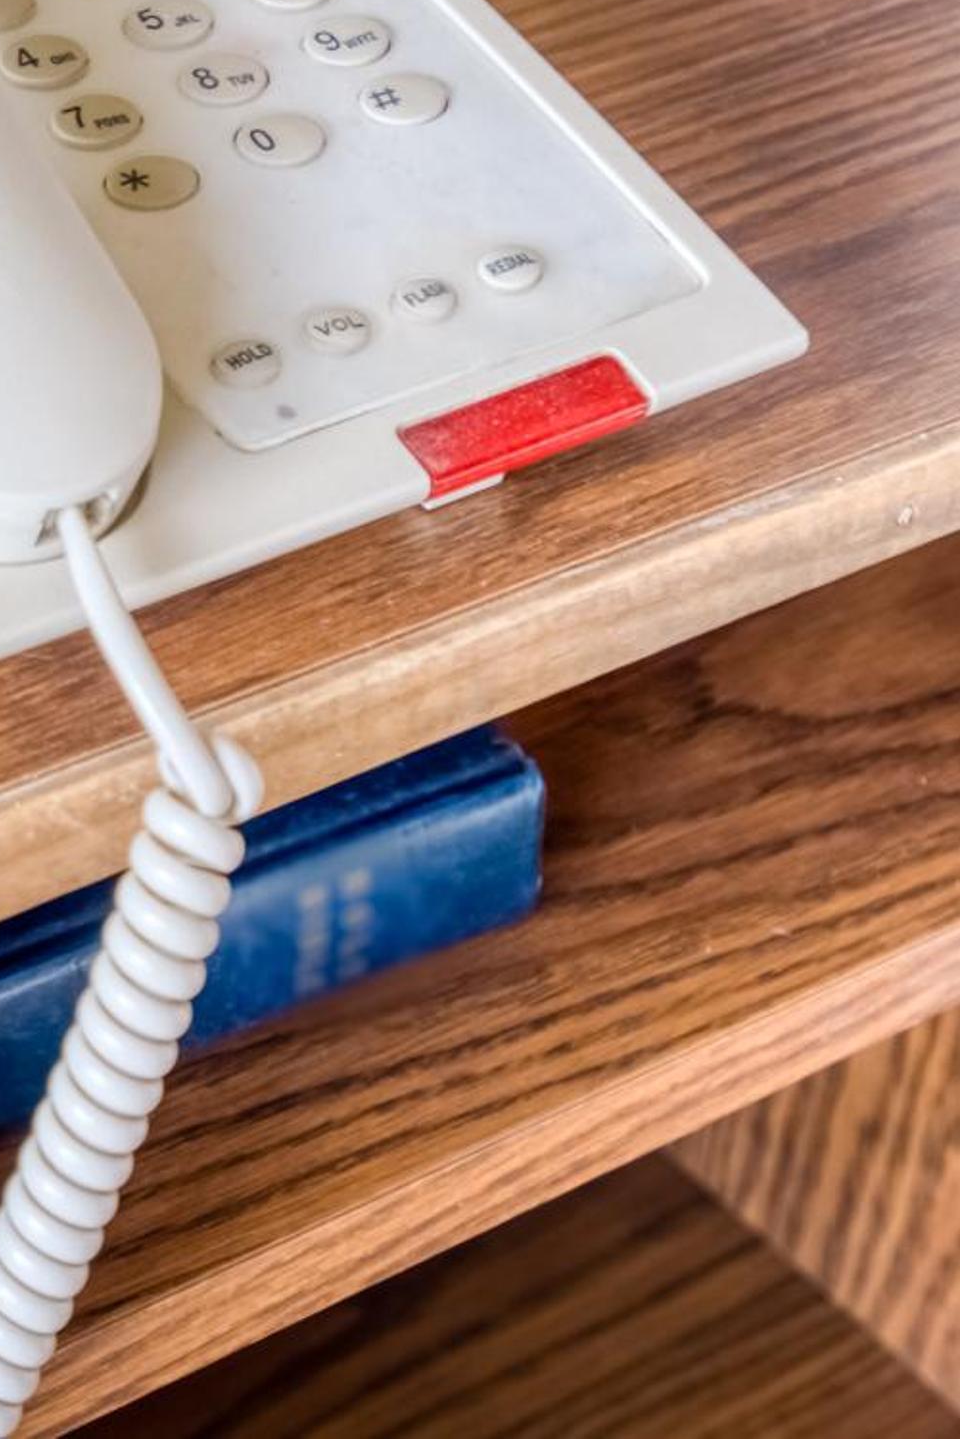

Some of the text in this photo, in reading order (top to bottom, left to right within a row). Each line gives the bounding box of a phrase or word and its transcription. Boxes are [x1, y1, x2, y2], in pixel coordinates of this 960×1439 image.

[137, 7, 164, 30] 5
[314, 30, 340, 51] 9
[17, 47, 40, 68] 4
[192, 67, 219, 90] 8
[369, 86, 401, 110] #
[61, 105, 85, 128] 7
[249, 128, 275, 152] 0
[486, 252, 536, 275] REDIAL
[403, 281, 450, 306] FLASH
[314, 313, 364, 336] VOL
[225, 343, 272, 370] HOLD
